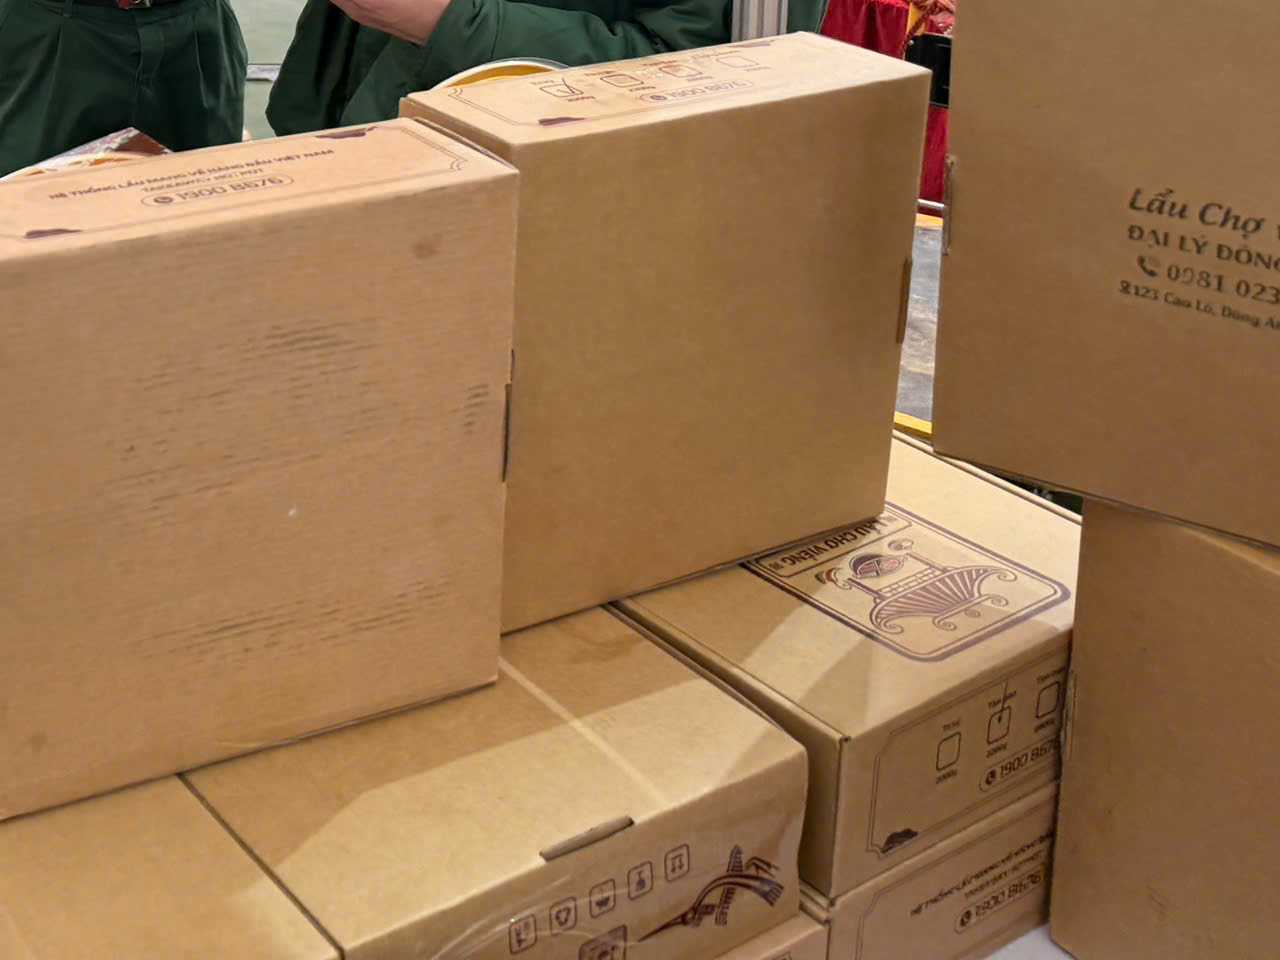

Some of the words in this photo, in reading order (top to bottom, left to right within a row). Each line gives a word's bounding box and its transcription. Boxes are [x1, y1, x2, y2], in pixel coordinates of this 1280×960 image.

[180, 185, 227, 201] 1900
[232, 177, 283, 193] 8676
[1128, 187, 1188, 219] Lẩu
[1198, 202, 1266, 240] Chợ
[1127, 224, 1170, 249] ĐẠI
[1167, 264, 1225, 293] 0981
[1235, 279, 1280, 305] 023
[1164, 291, 1192, 309] Cao
